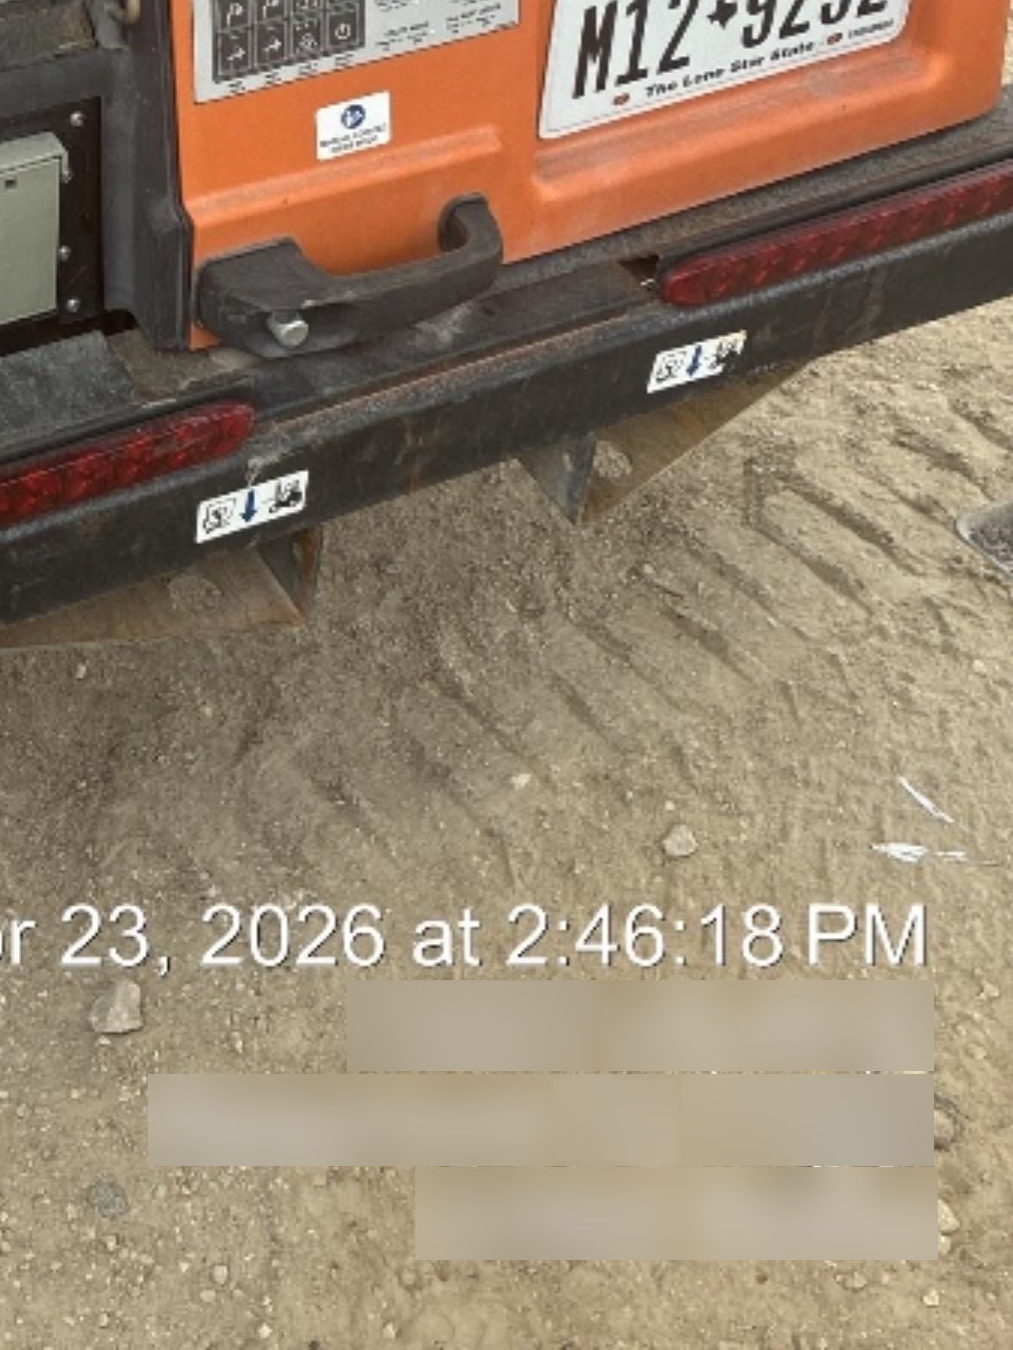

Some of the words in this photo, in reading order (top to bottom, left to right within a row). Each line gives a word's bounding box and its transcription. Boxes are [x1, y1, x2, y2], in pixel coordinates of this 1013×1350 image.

[645, 82, 678, 97] The
[682, 68, 724, 88] Lone
[730, 55, 765, 73] Star
[770, 41, 814, 61] State
